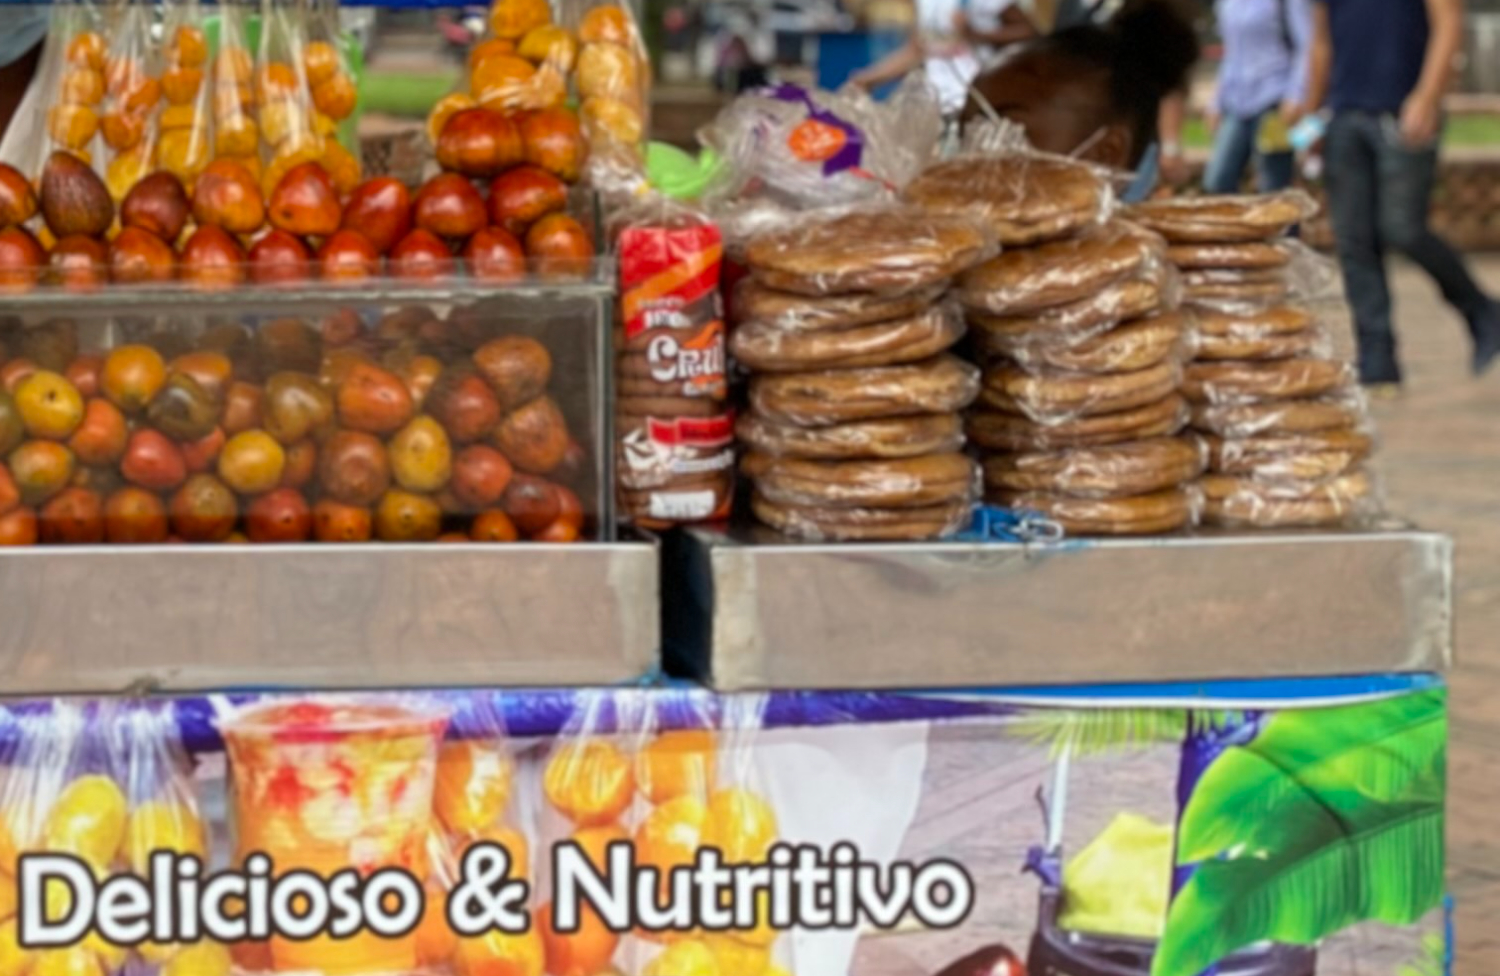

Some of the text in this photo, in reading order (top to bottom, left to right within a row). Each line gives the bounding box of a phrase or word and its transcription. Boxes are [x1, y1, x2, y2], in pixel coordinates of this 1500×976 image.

[17, 840, 974, 948] Delicioso & Nutritivo
